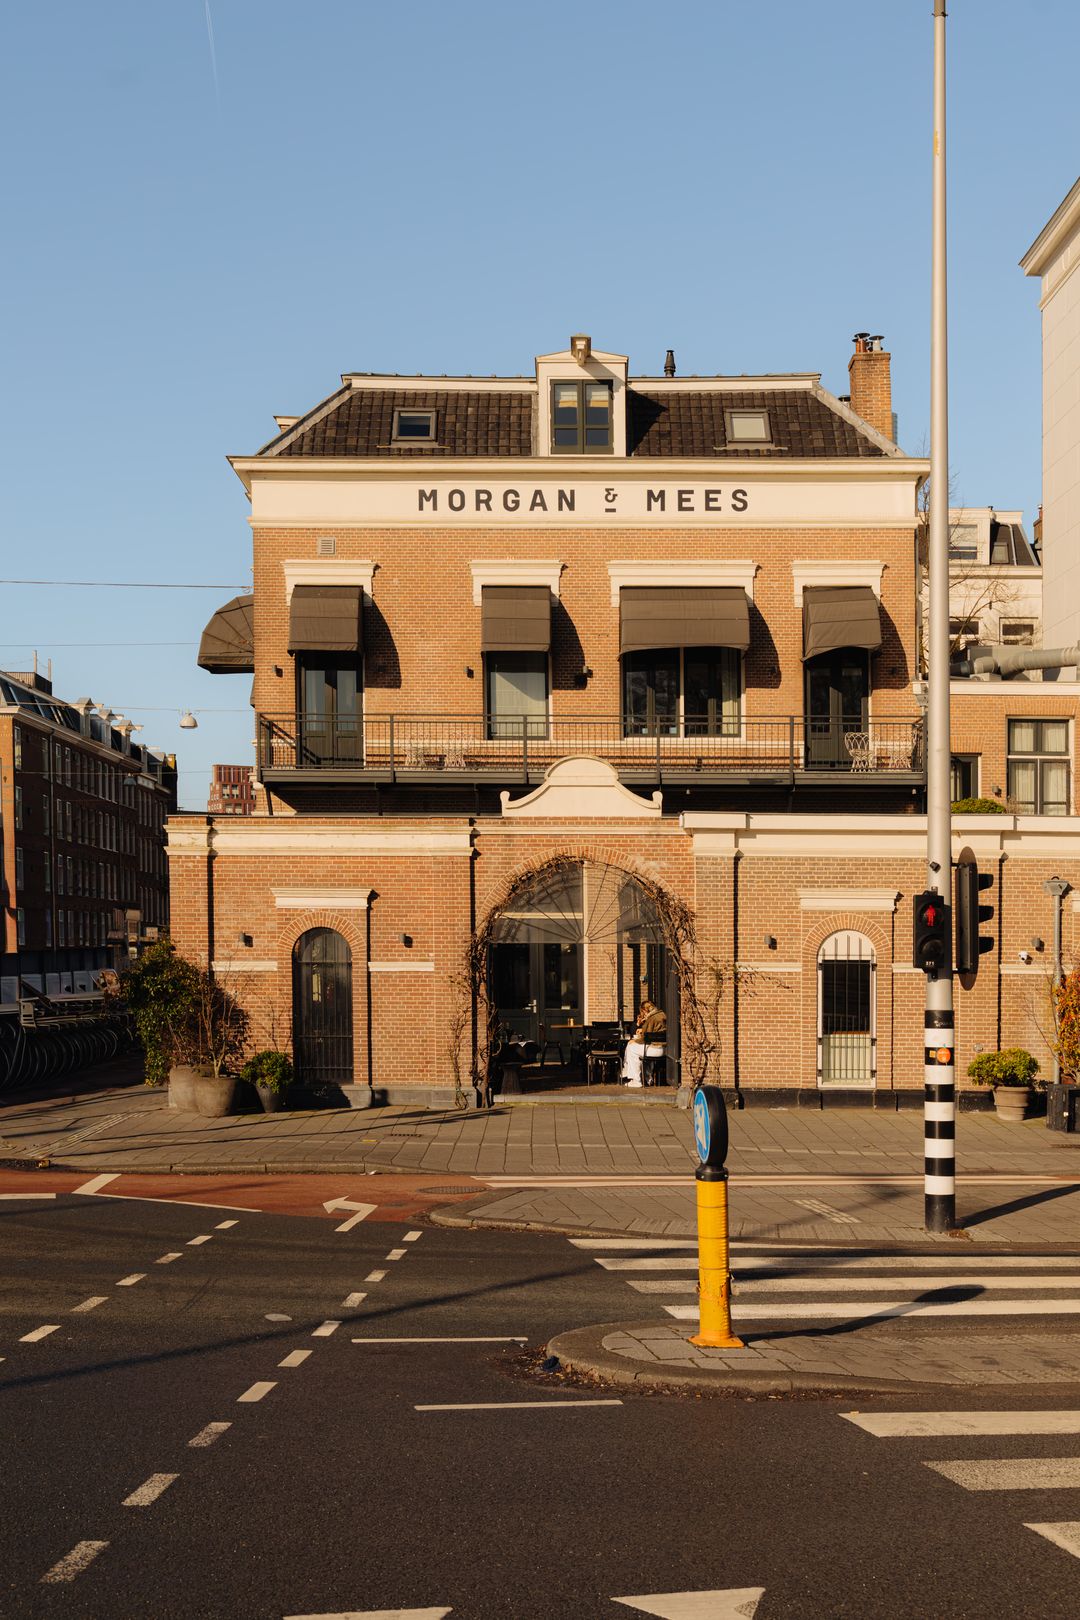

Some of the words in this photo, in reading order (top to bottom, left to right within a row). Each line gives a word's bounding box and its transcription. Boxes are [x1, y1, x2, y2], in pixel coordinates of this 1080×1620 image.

[418, 488, 576, 512] MORGAN
[604, 487, 618, 513] &
[646, 488, 748, 512] MEES
